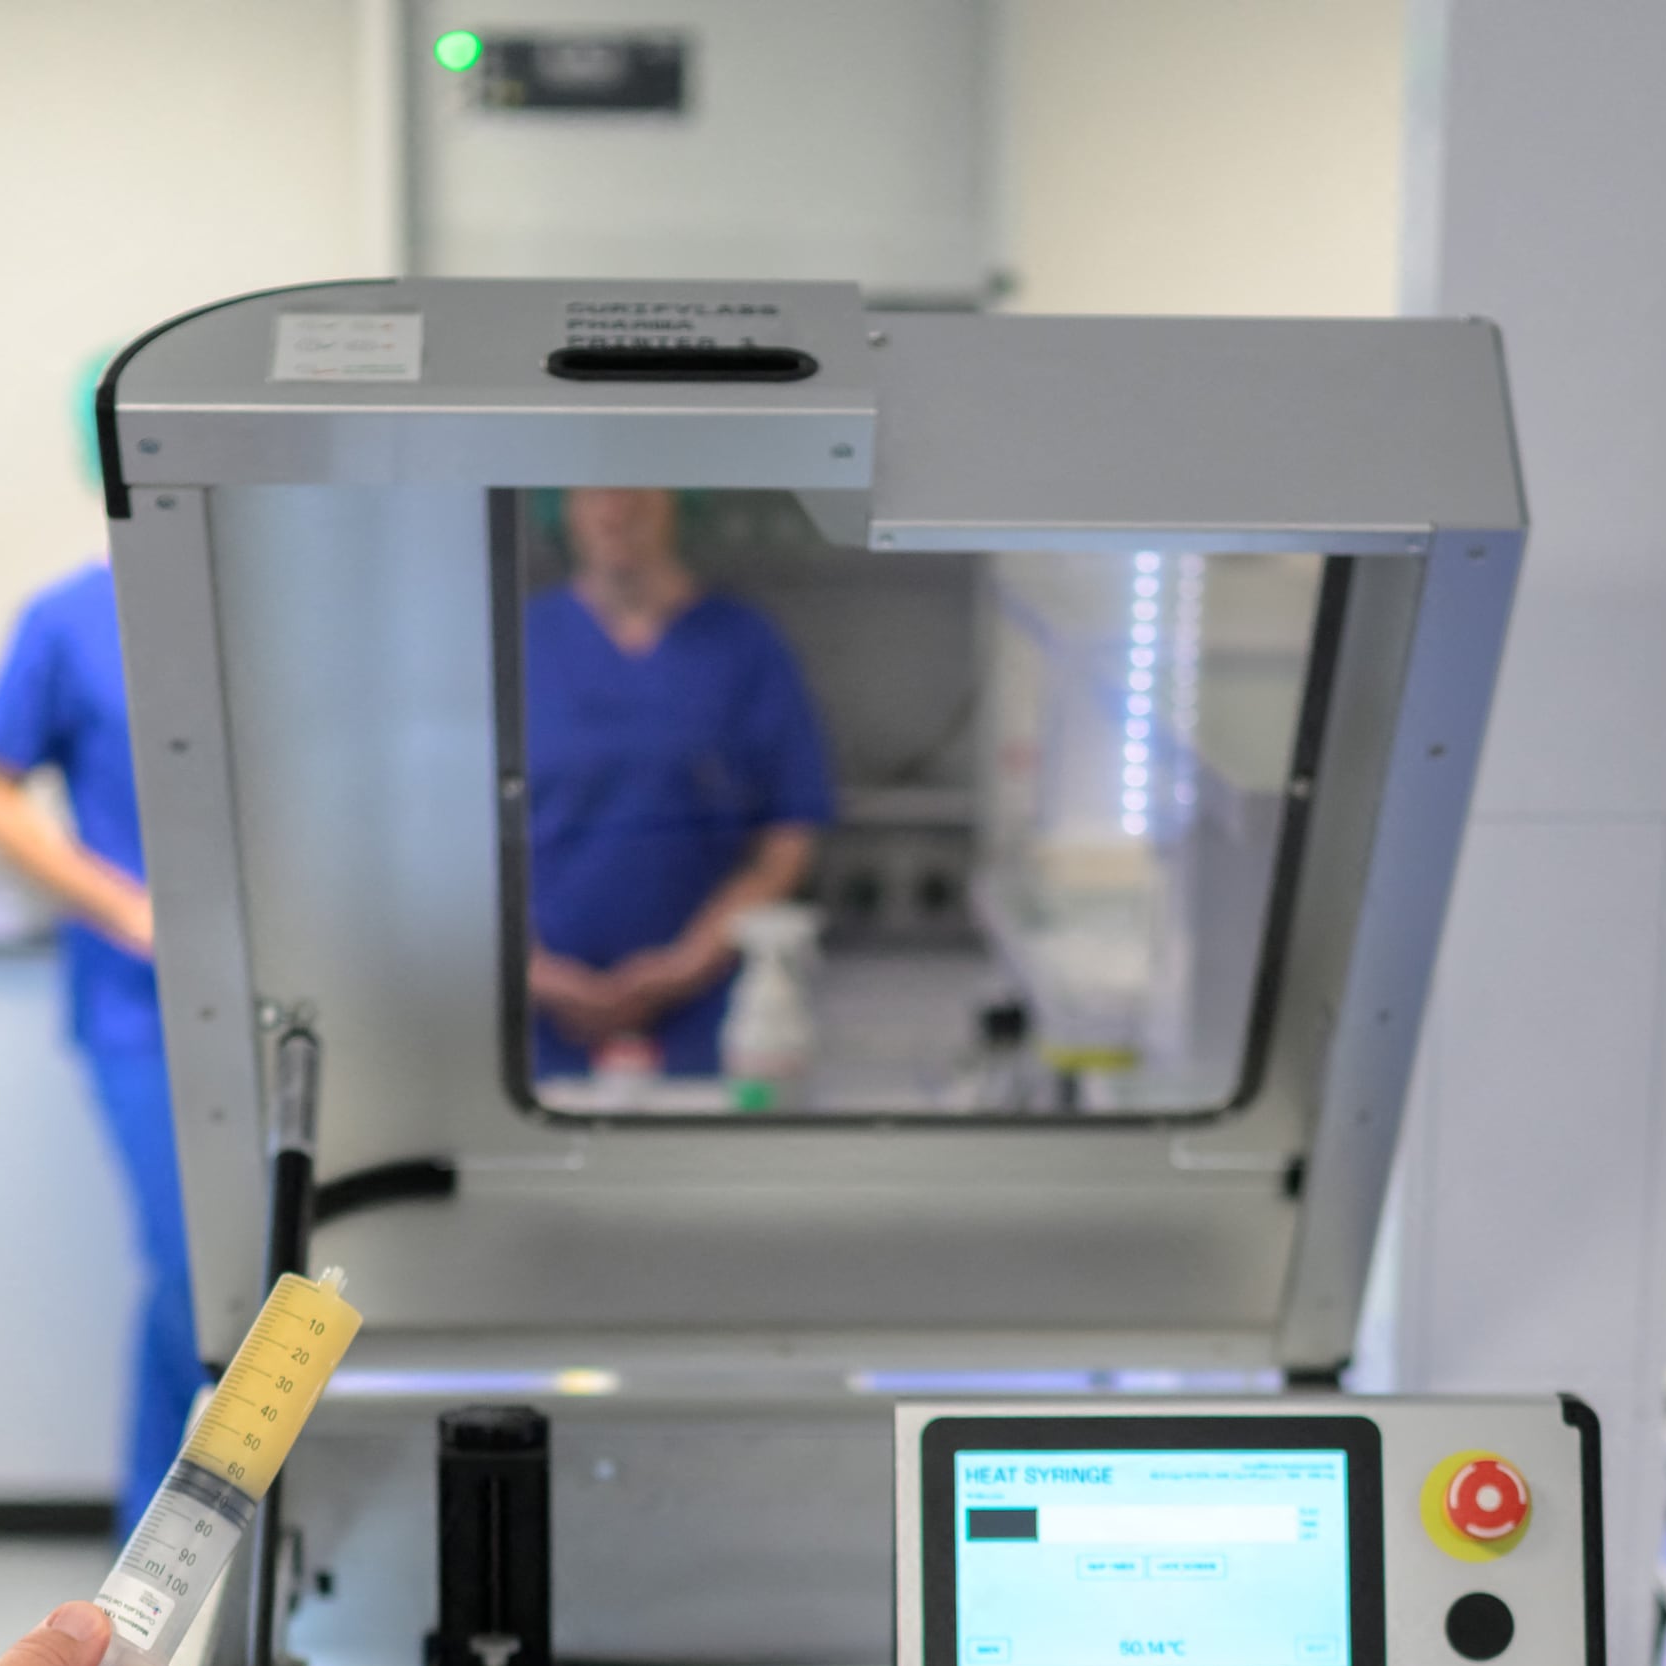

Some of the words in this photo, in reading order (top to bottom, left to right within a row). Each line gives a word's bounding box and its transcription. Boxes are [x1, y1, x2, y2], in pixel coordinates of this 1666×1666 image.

[308, 1318, 325, 1336] 10
[290, 1347, 310, 1366] 20
[275, 1375, 294, 1394] 30
[260, 1404, 278, 1423] 40
[243, 1433, 262, 1451] 50
[227, 1462, 245, 1480] 60
[964, 1465, 1018, 1485] HEAT
[1024, 1465, 1114, 1486] SYRINGE
[194, 1519, 213, 1538] 80
[177, 1547, 197, 1567] 90
[145, 1559, 166, 1576] ml
[165, 1573, 189, 1596] 100
